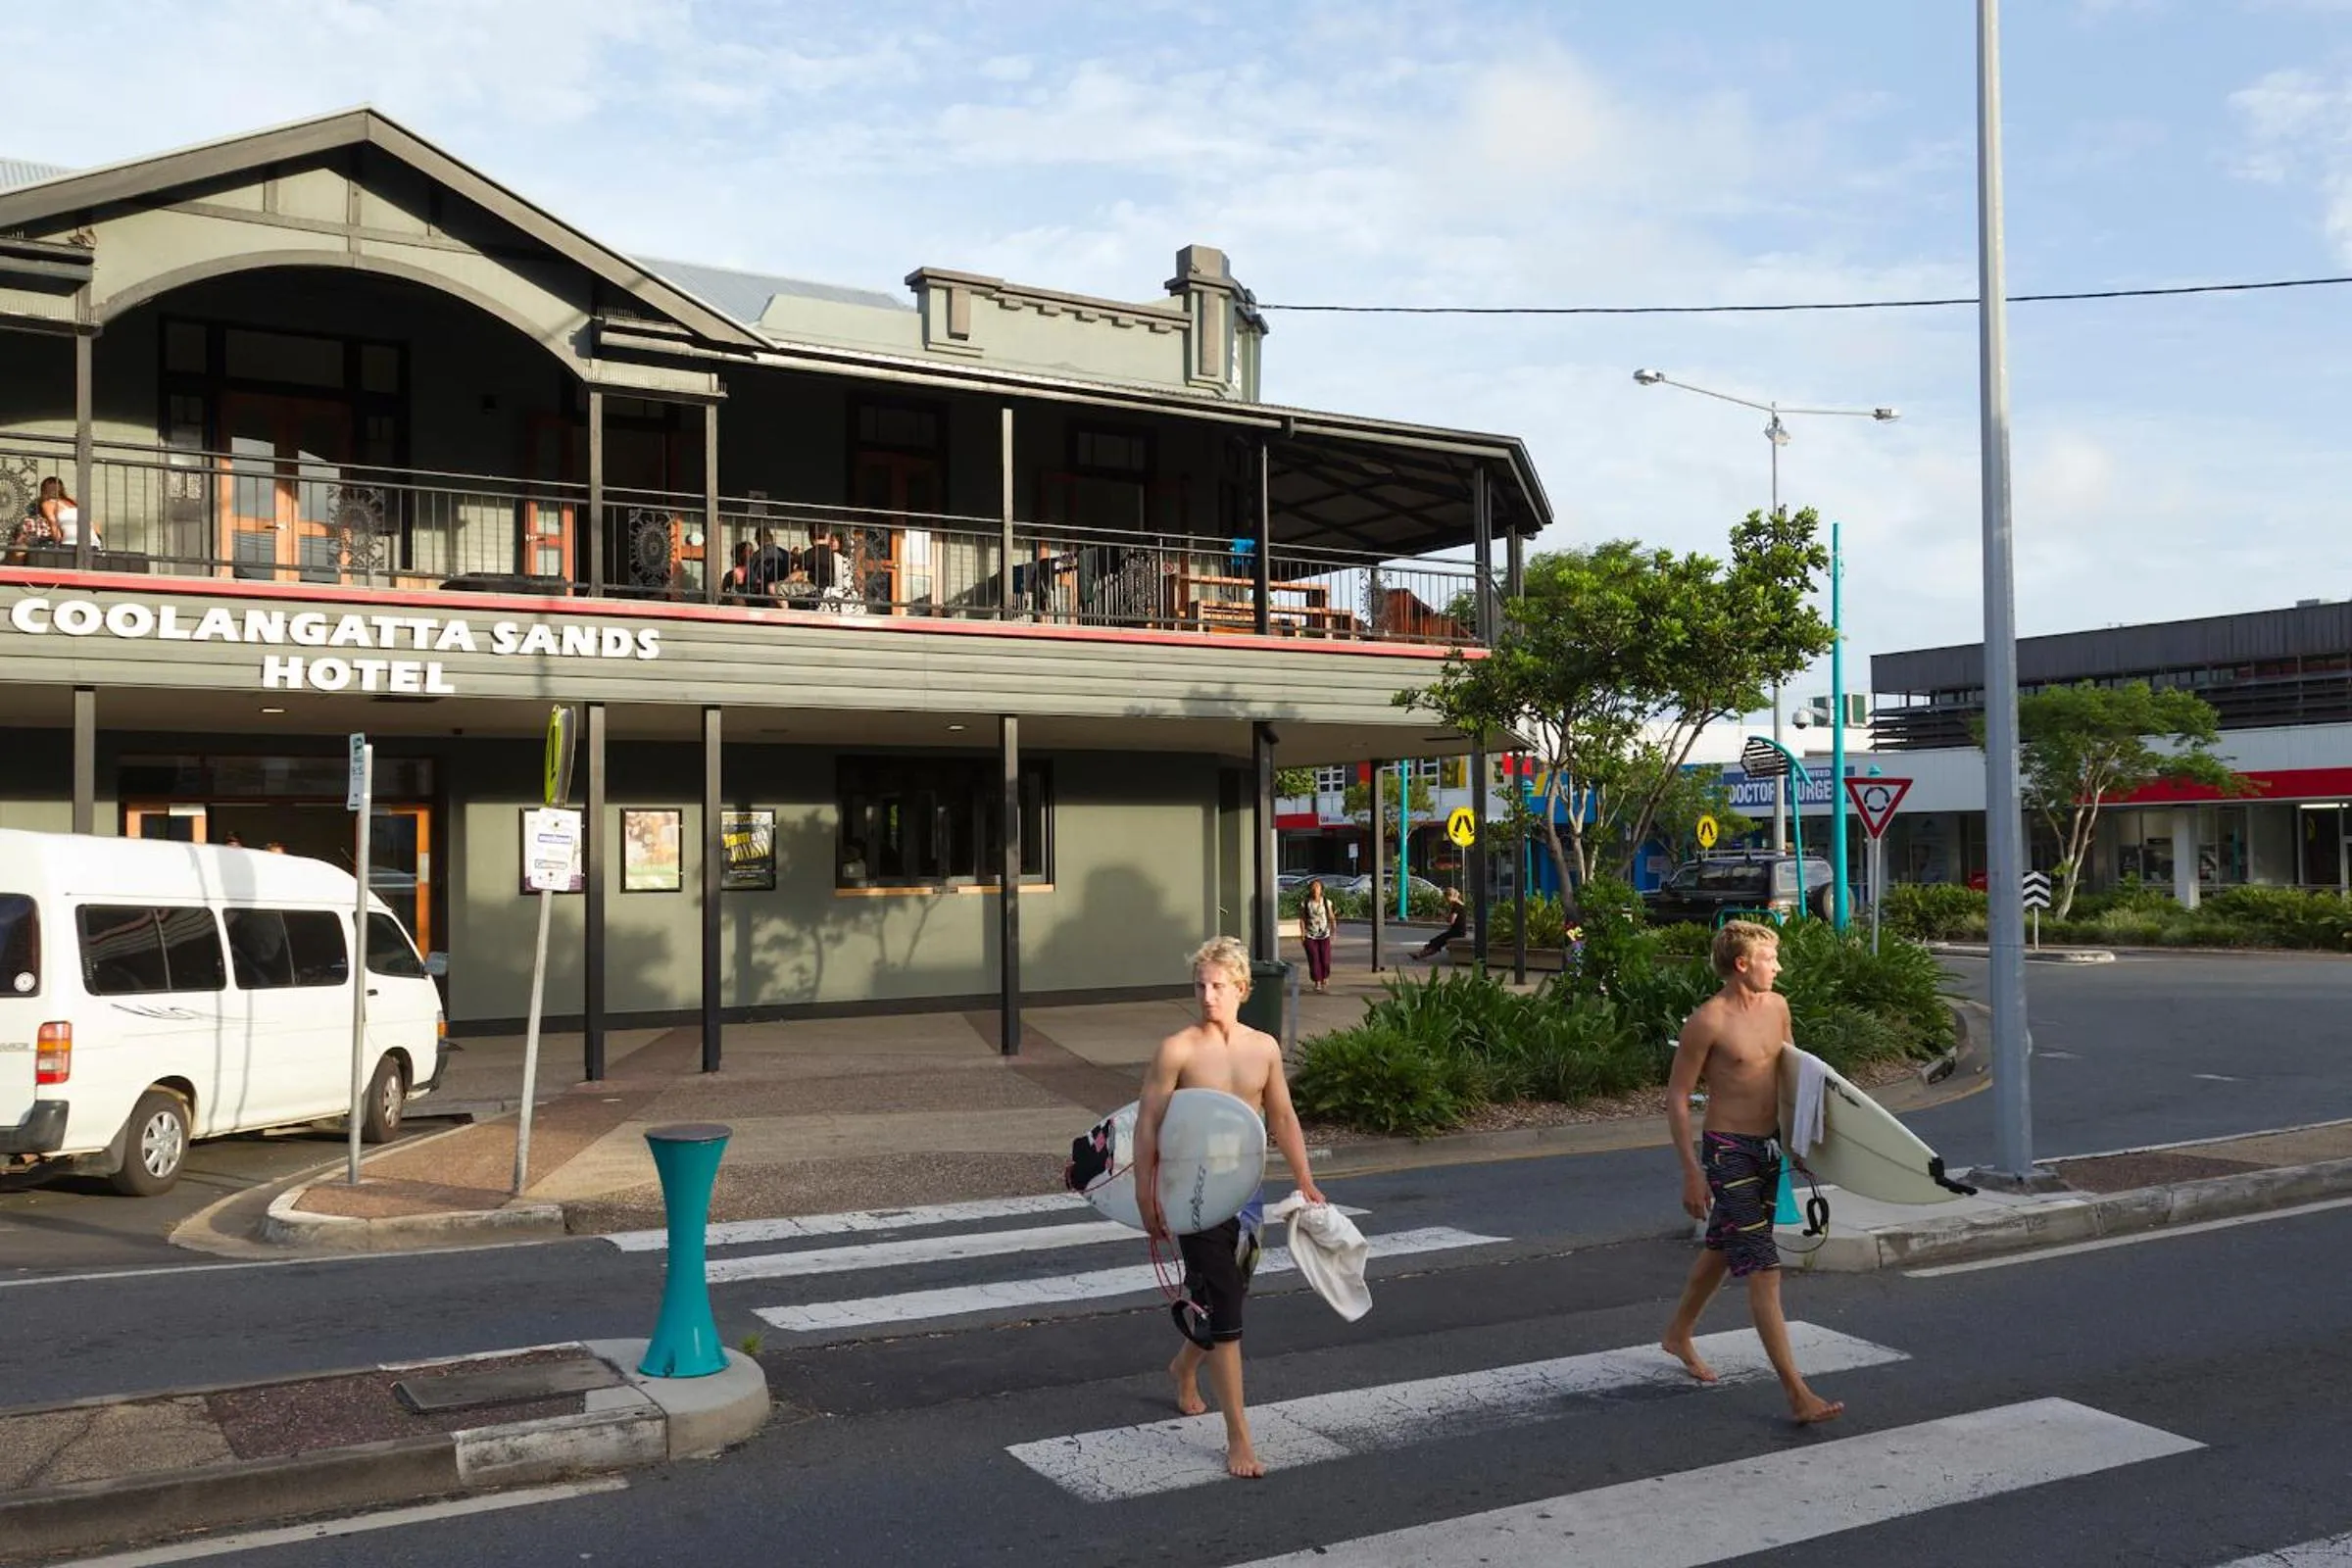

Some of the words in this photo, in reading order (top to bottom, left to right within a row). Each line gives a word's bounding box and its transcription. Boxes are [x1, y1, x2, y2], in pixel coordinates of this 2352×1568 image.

[11, 598, 477, 652] COOLANGATTA
[491, 621, 661, 660] SANDS
[261, 655, 455, 694] HOTEL
